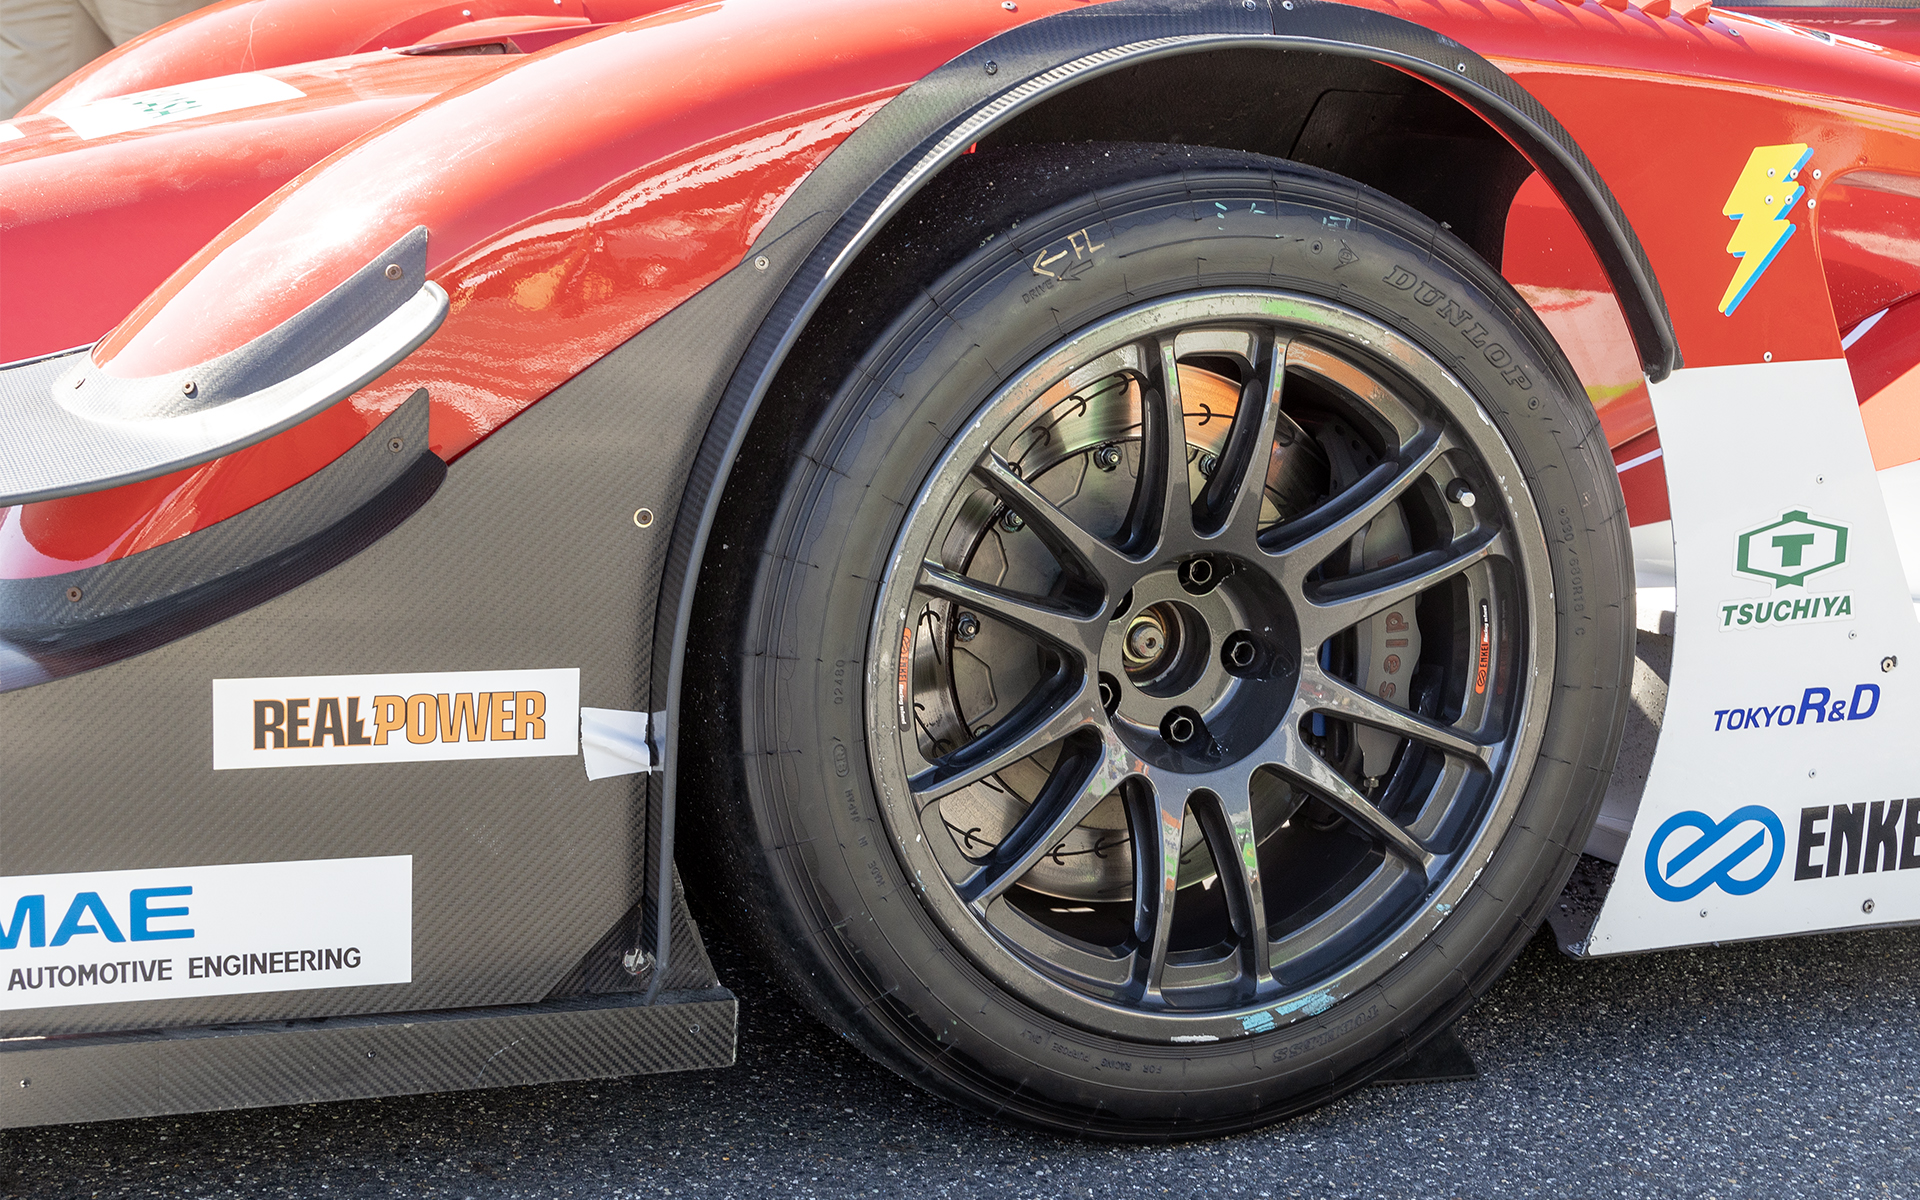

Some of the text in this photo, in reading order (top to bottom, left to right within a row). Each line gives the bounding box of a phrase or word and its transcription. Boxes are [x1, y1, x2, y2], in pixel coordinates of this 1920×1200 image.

[1067, 228, 1105, 260] FL
[1021, 278, 1055, 305] DRIVE
[1382, 264, 1533, 391] DUNLOP
[1722, 595, 1852, 627] TSUCHIYA
[1479, 643, 1489, 668] ENKEI
[845, 788, 887, 888] MADE IN JAPAN
[1793, 797, 1920, 882] ENKE
[0, 885, 196, 951] MAE
[7, 946, 363, 992] AUTOMOTIVE ENGINEERING
[1272, 1004, 1379, 1063] TUBELESS
[1050, 1041, 1091, 1063] PURPOSE
[1100, 1058, 1132, 1073] RACING
[1142, 1064, 1163, 1075] FOR
